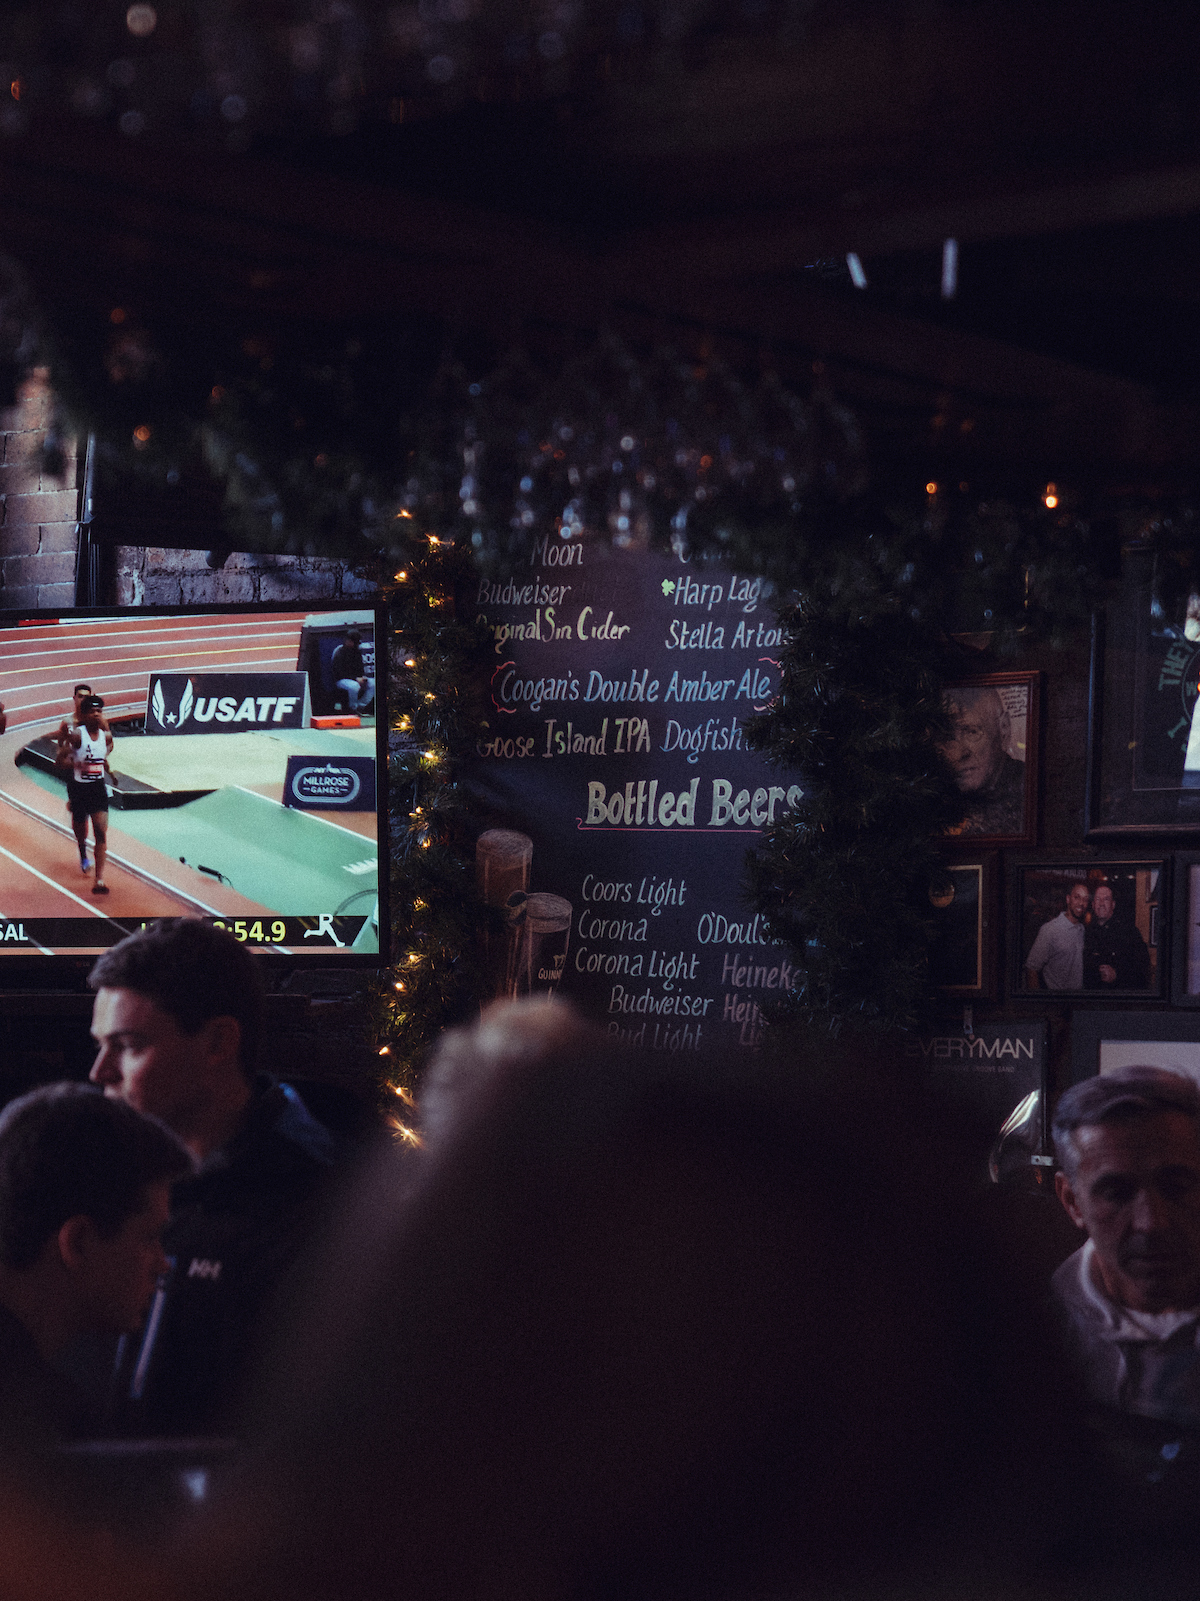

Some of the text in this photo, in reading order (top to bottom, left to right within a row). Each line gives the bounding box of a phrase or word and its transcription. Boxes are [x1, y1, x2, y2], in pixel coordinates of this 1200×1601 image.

[529, 533, 584, 567] Moon
[476, 576, 572, 605] Budweiser
[674, 576, 724, 611] Harp
[727, 574, 763, 613] Lag
[541, 606, 572, 643] Sin
[576, 605, 631, 641] Cider
[665, 619, 784, 650] Stella Artoi
[500, 668, 772, 712] Coogan's Double Amber Ale
[193, 696, 301, 723] USATF
[542, 717, 608, 759] Island
[614, 716, 651, 753] IPA
[659, 716, 742, 764] Dogfish
[303, 776, 349, 787] MILLROSE
[310, 785, 340, 794] GAMES
[585, 777, 805, 827] Bottled Beers
[582, 874, 688, 917] Coors Light
[578, 909, 648, 942] Corona
[575, 947, 644, 977] Corona
[647, 950, 701, 991] Light
[607, 984, 715, 1017] Budweiser
[653, 1022, 704, 1054] Light
[904, 1036, 1035, 1060] EVERYMAN
